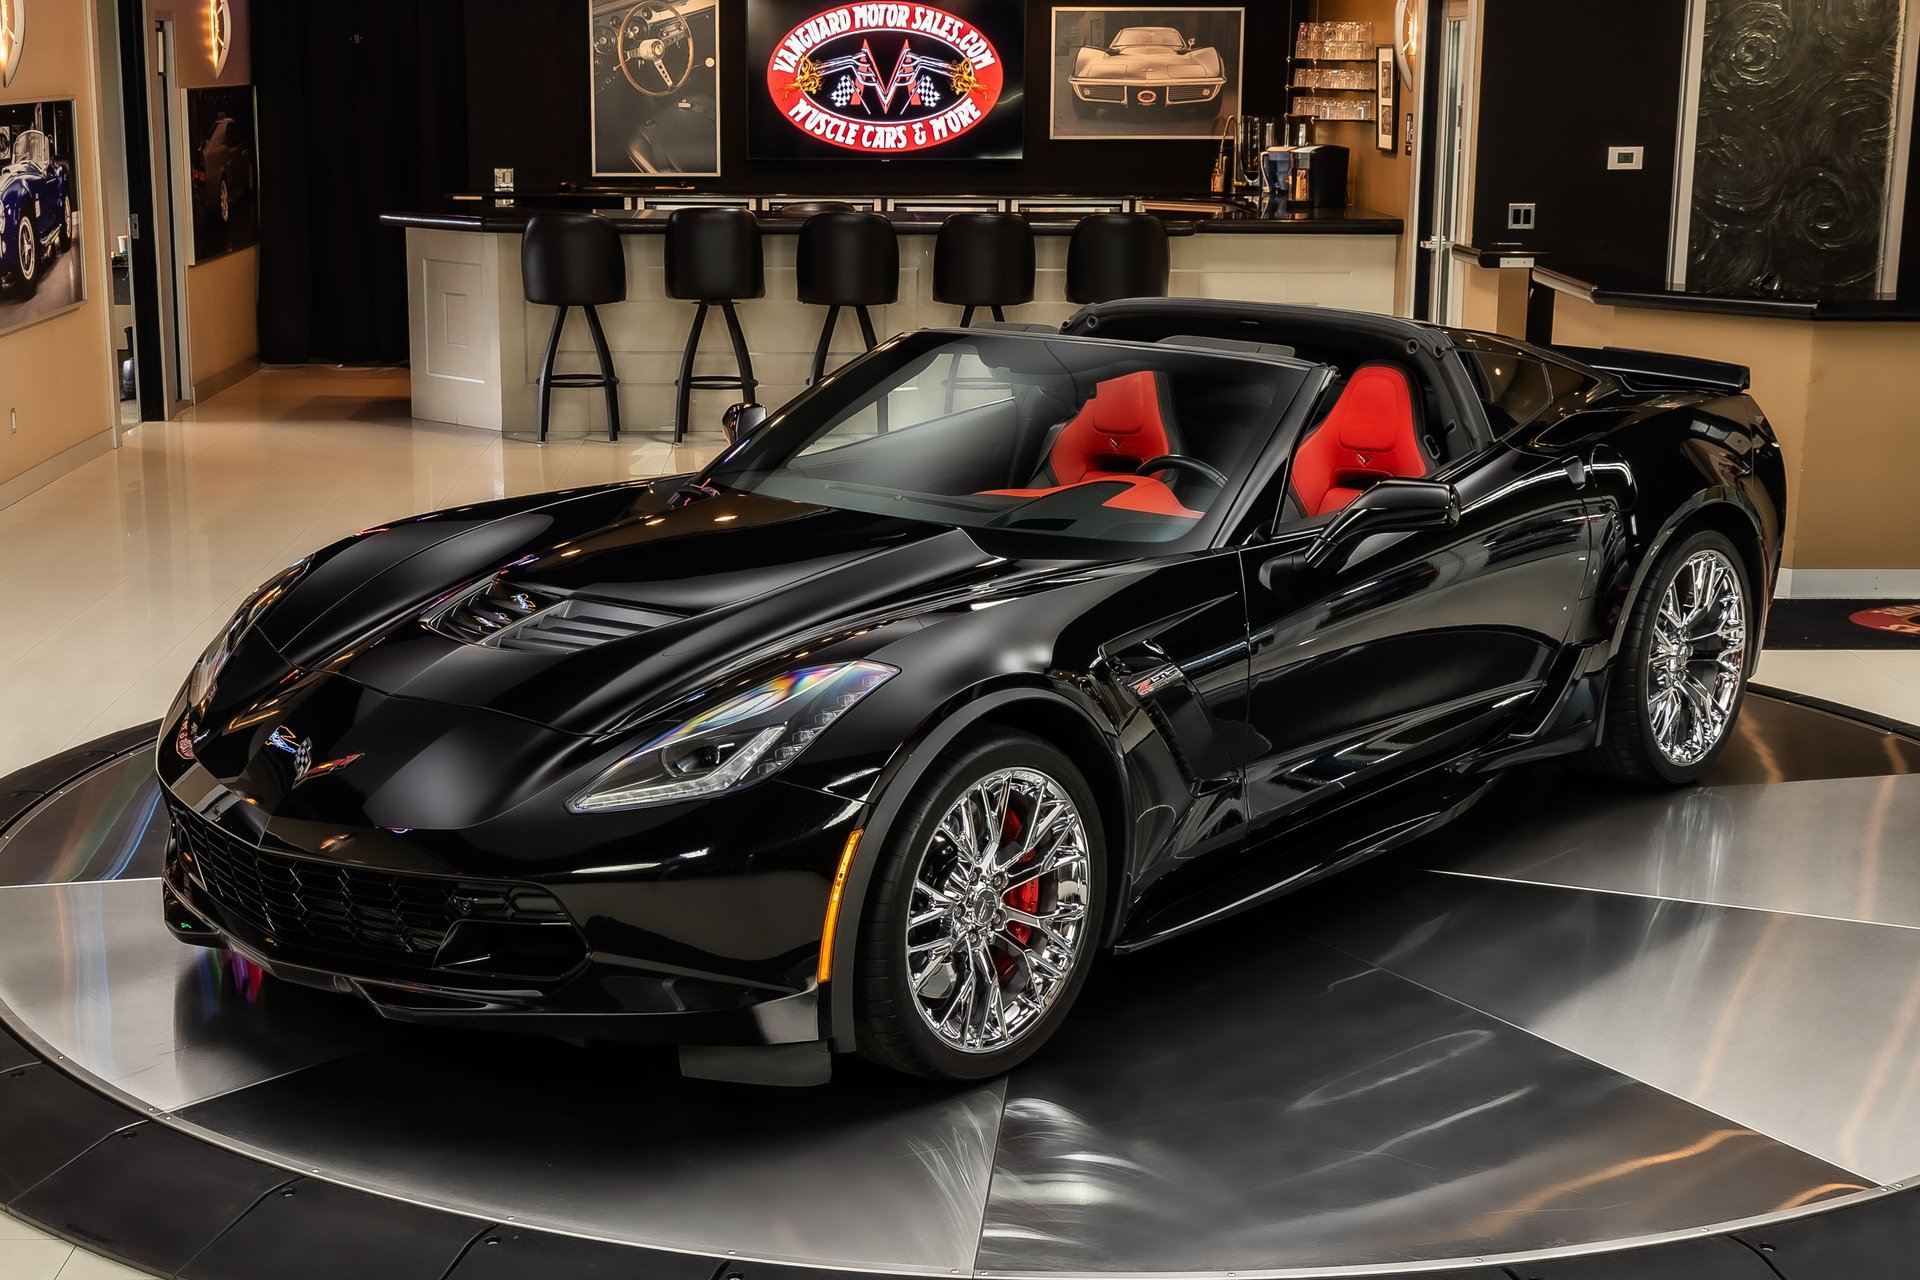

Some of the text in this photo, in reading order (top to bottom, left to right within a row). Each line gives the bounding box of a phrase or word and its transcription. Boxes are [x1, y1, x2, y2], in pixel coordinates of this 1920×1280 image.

[773, 3, 996, 73] VANGUARD MOTOR SALES.COM
[787, 97, 982, 149] MUSCLE CARS & MORE
